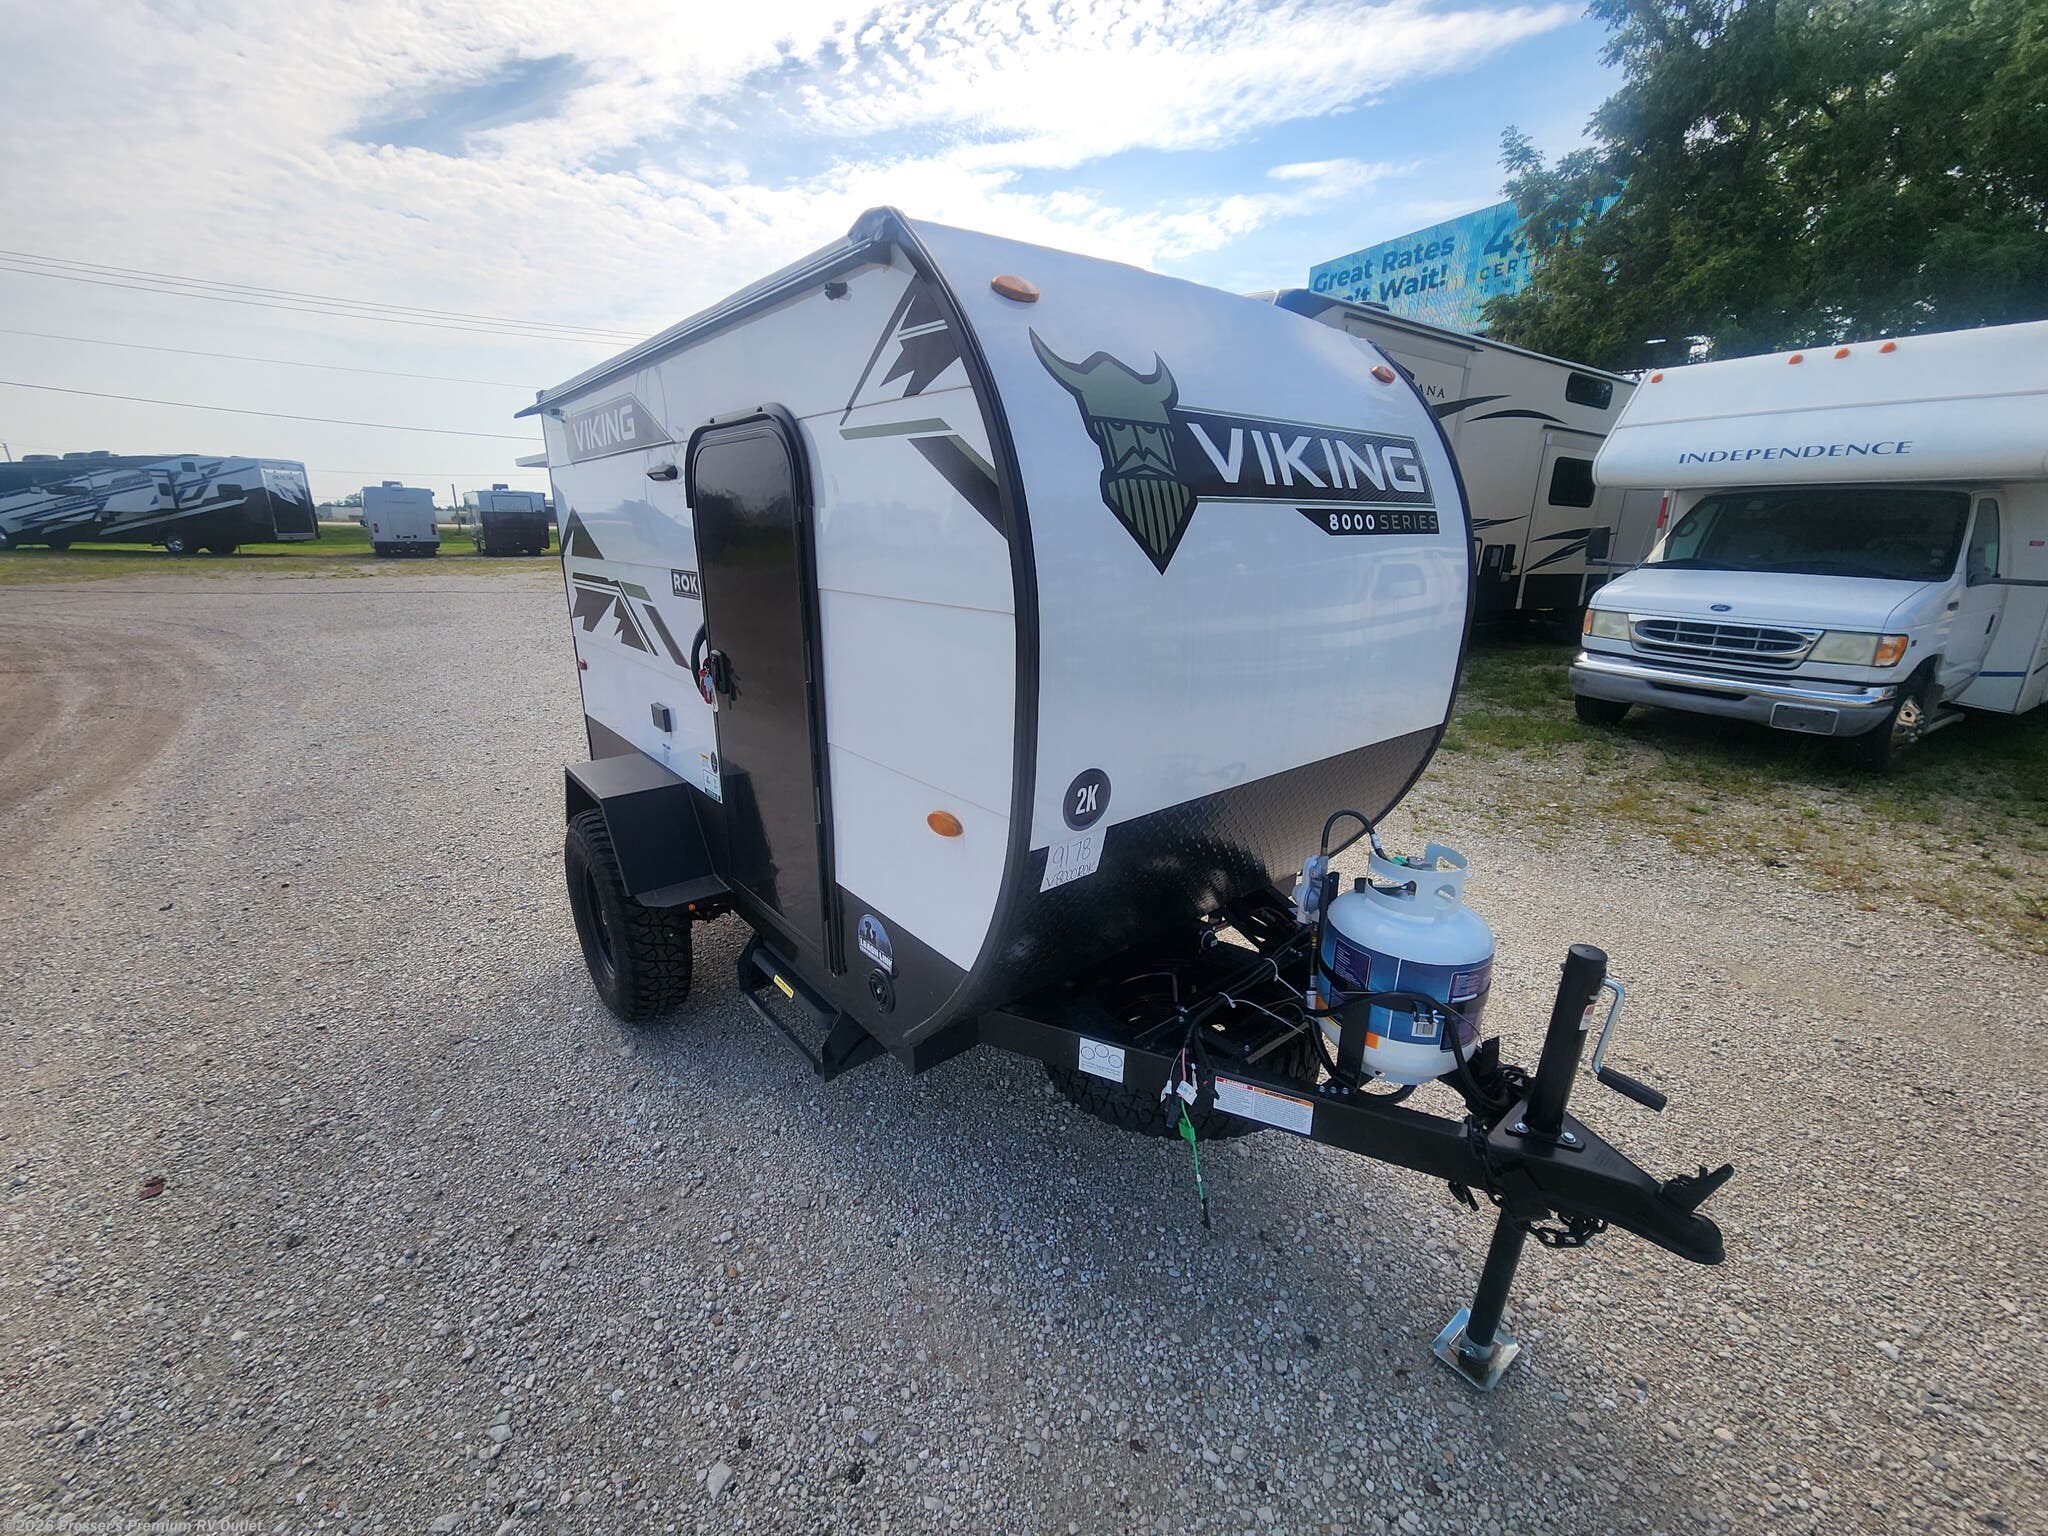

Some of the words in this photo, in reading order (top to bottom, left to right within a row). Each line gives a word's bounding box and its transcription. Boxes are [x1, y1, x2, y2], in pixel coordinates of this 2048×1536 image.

[1313, 258, 1373, 293] Great
[1381, 235, 1455, 274] Rates
[1378, 263, 1449, 302] Wait!
[573, 403, 636, 452] VIKING
[1185, 421, 1425, 494] VIKING
[1678, 440, 1915, 464] INDEPENDENCE
[1328, 513, 1376, 531] 8000
[1380, 514, 1438, 531] SERIES
[672, 572, 698, 593] ROK
[1075, 783, 1100, 816] 2K
[1052, 837, 1091, 868] 9178
